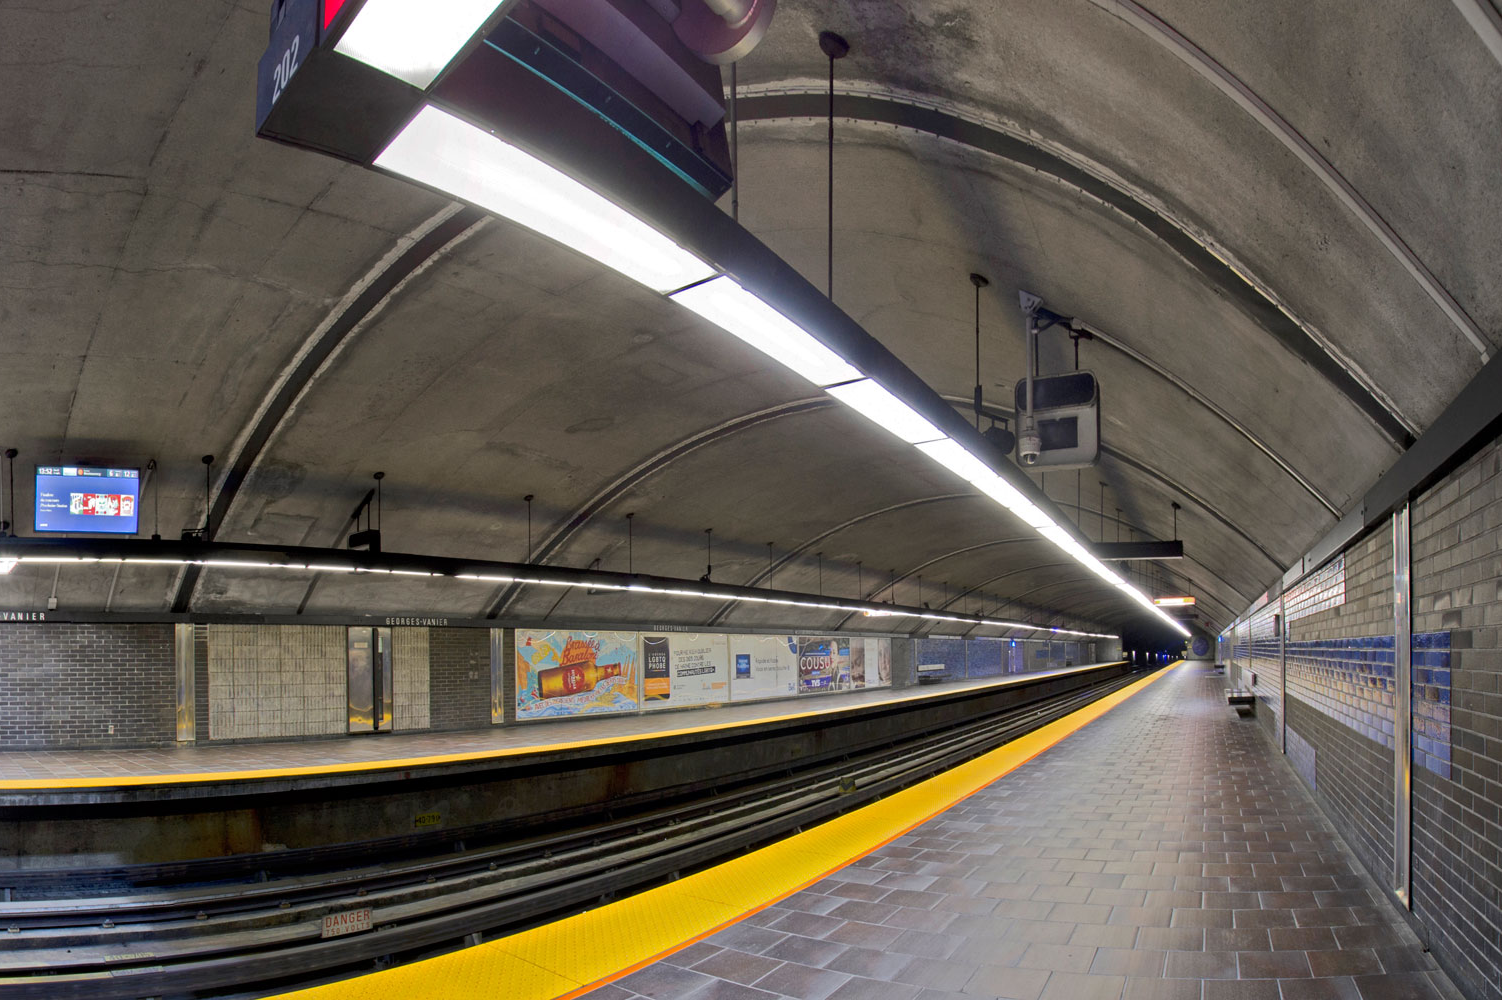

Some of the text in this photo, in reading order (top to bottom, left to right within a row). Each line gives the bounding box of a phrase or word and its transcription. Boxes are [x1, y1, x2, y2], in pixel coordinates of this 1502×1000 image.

[272, 34, 300, 105] 202
[385, 617, 448, 627] GEORGES-VANIER
[325, 909, 371, 929] DANGER
[345, 921, 371, 934] VOLTS
